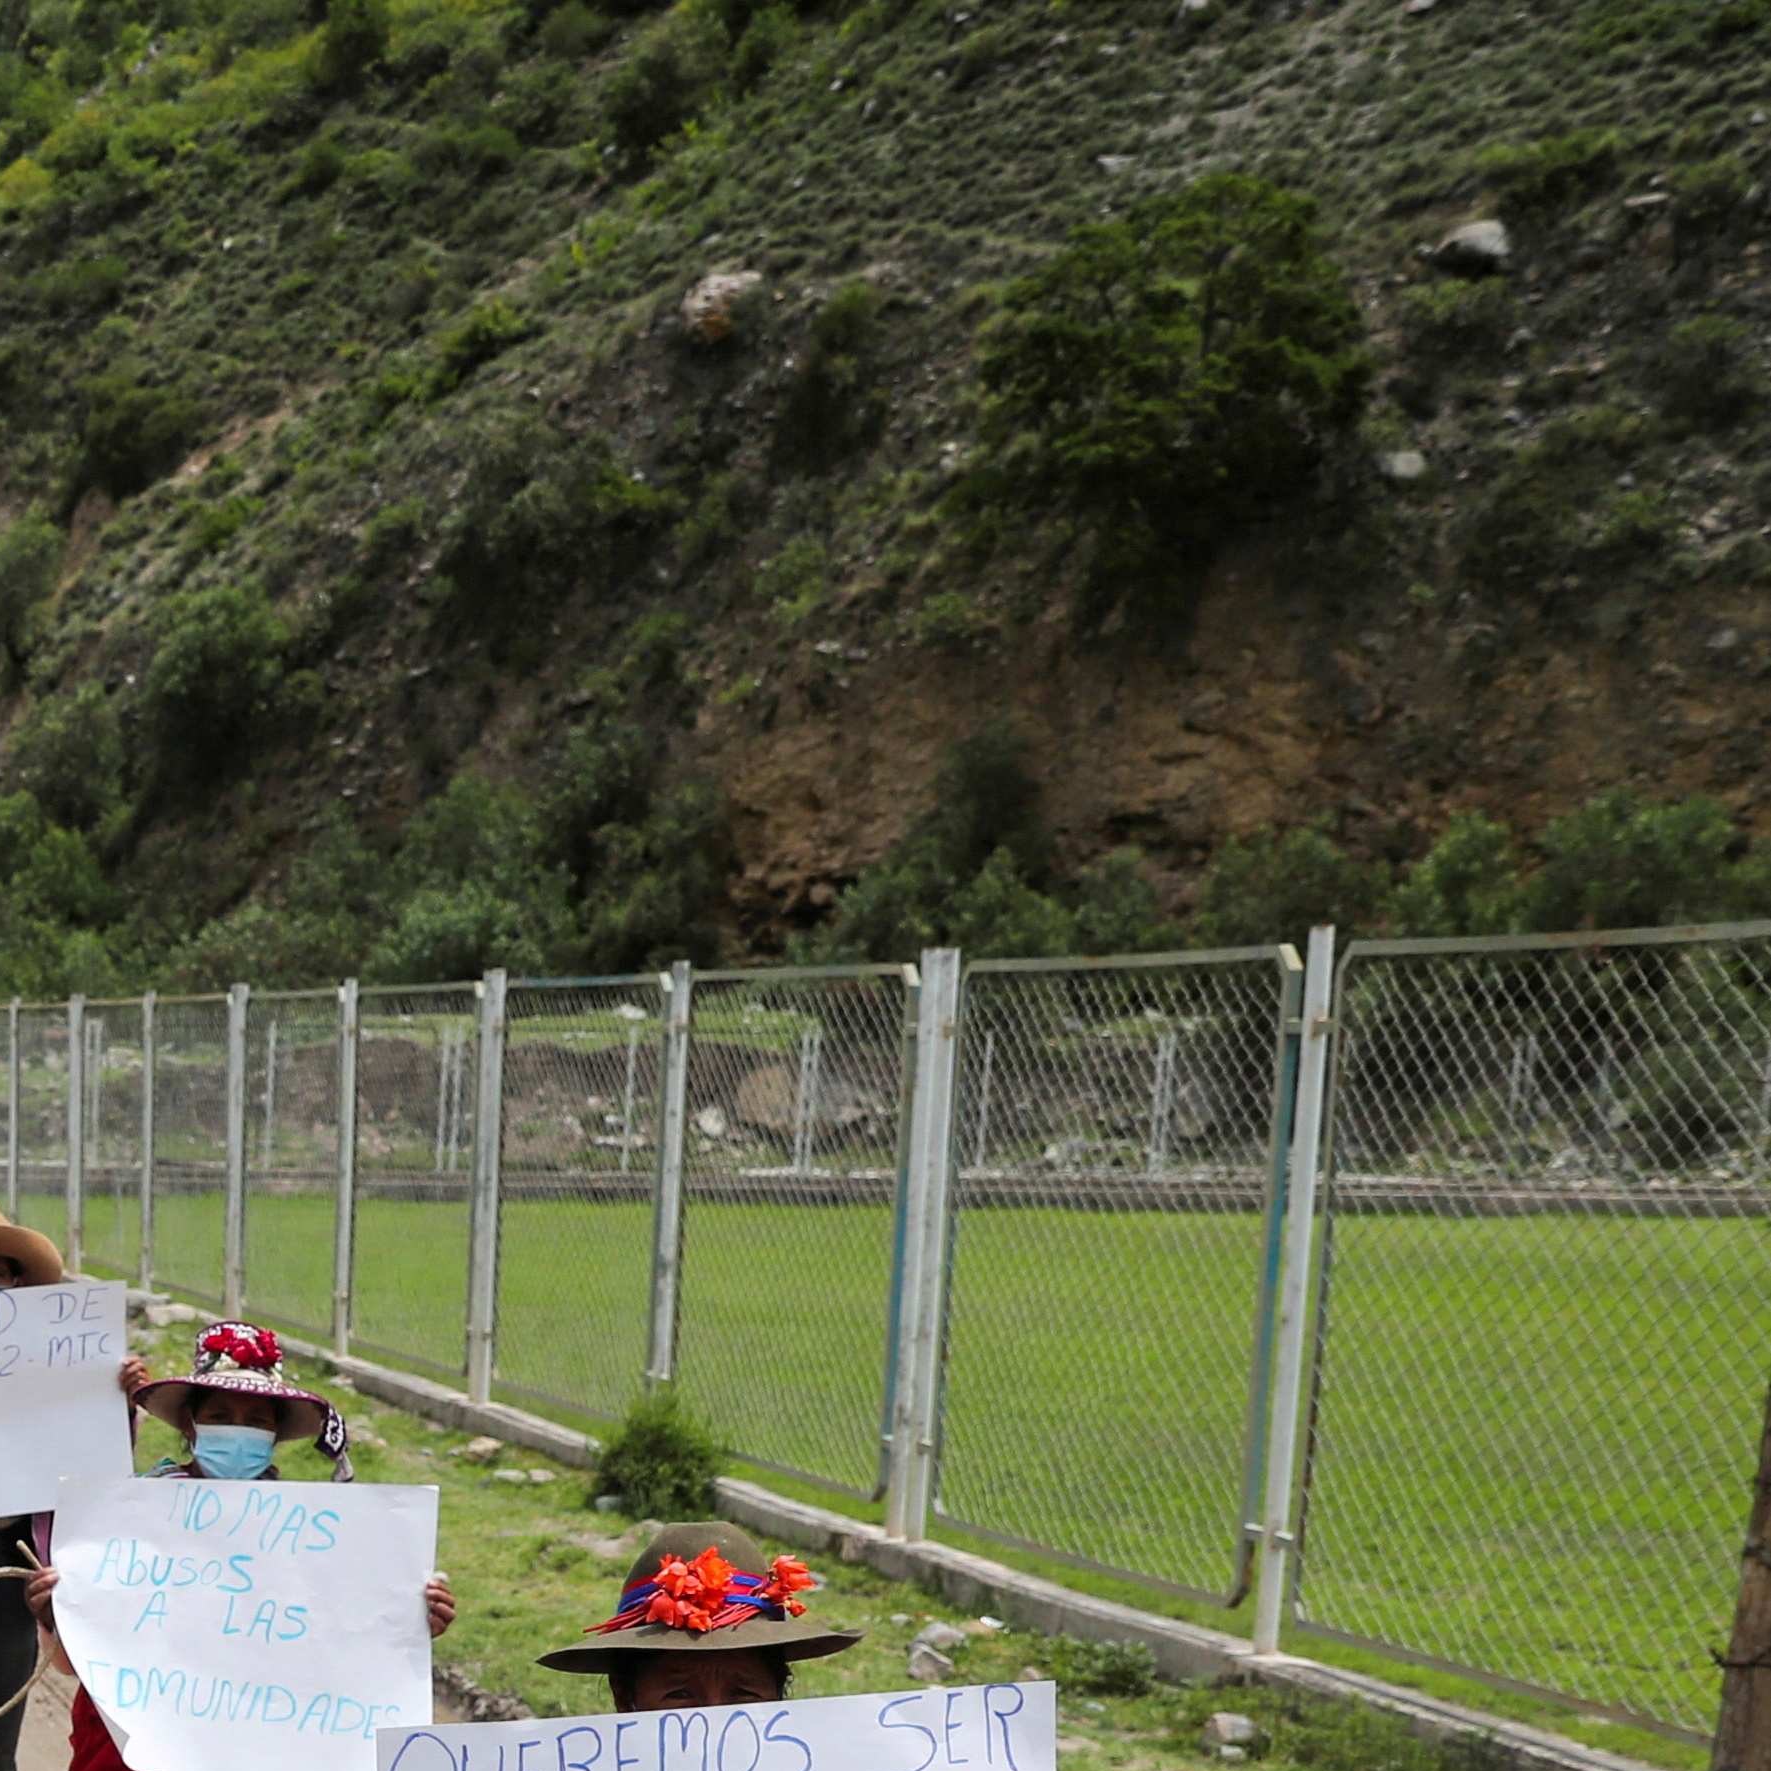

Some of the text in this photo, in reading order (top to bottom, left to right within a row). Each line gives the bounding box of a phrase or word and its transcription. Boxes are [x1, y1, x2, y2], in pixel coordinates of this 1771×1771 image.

[46, 1287, 109, 1325] DE
[167, 1482, 341, 1554] NO MAS
[133, 1590, 308, 1644] A LAS
